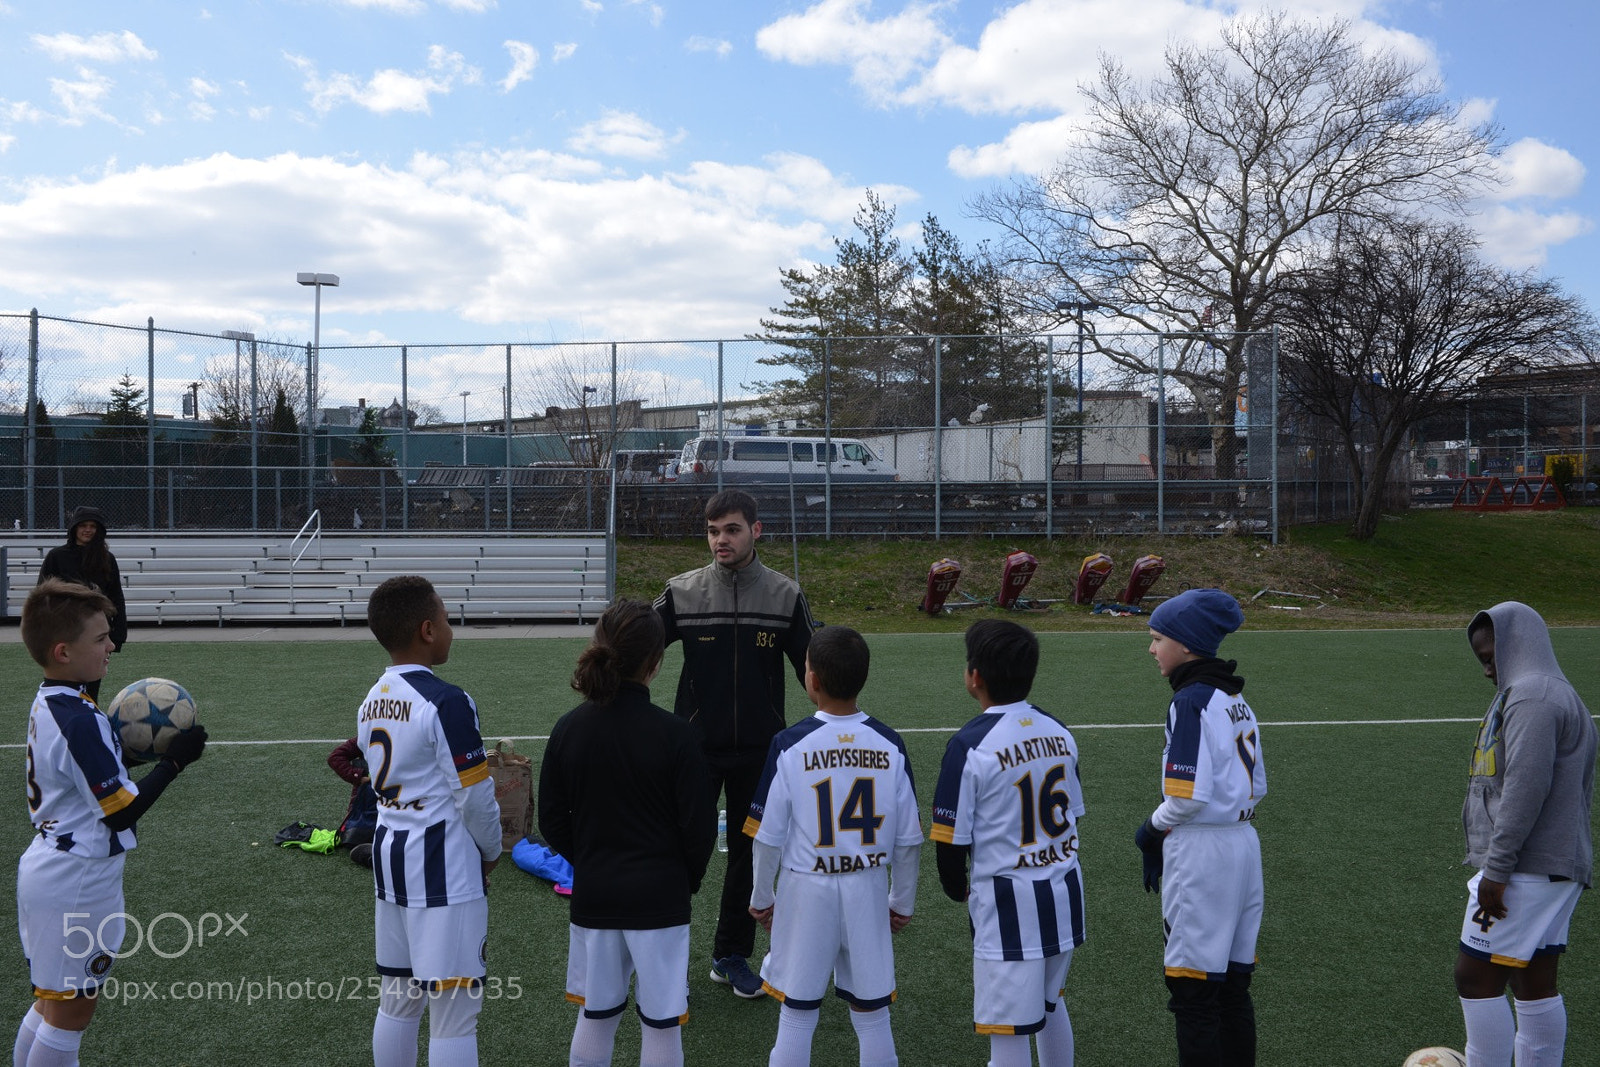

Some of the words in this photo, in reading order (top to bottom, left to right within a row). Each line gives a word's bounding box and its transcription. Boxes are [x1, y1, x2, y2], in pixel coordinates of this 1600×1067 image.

[369, 727, 402, 801] 2
[802, 748, 890, 772] LAVEYSSIERES
[995, 736, 1071, 771] MARTINEZ
[811, 776, 886, 849] 14
[1013, 763, 1071, 847] 16
[811, 855, 865, 874] ALBA
